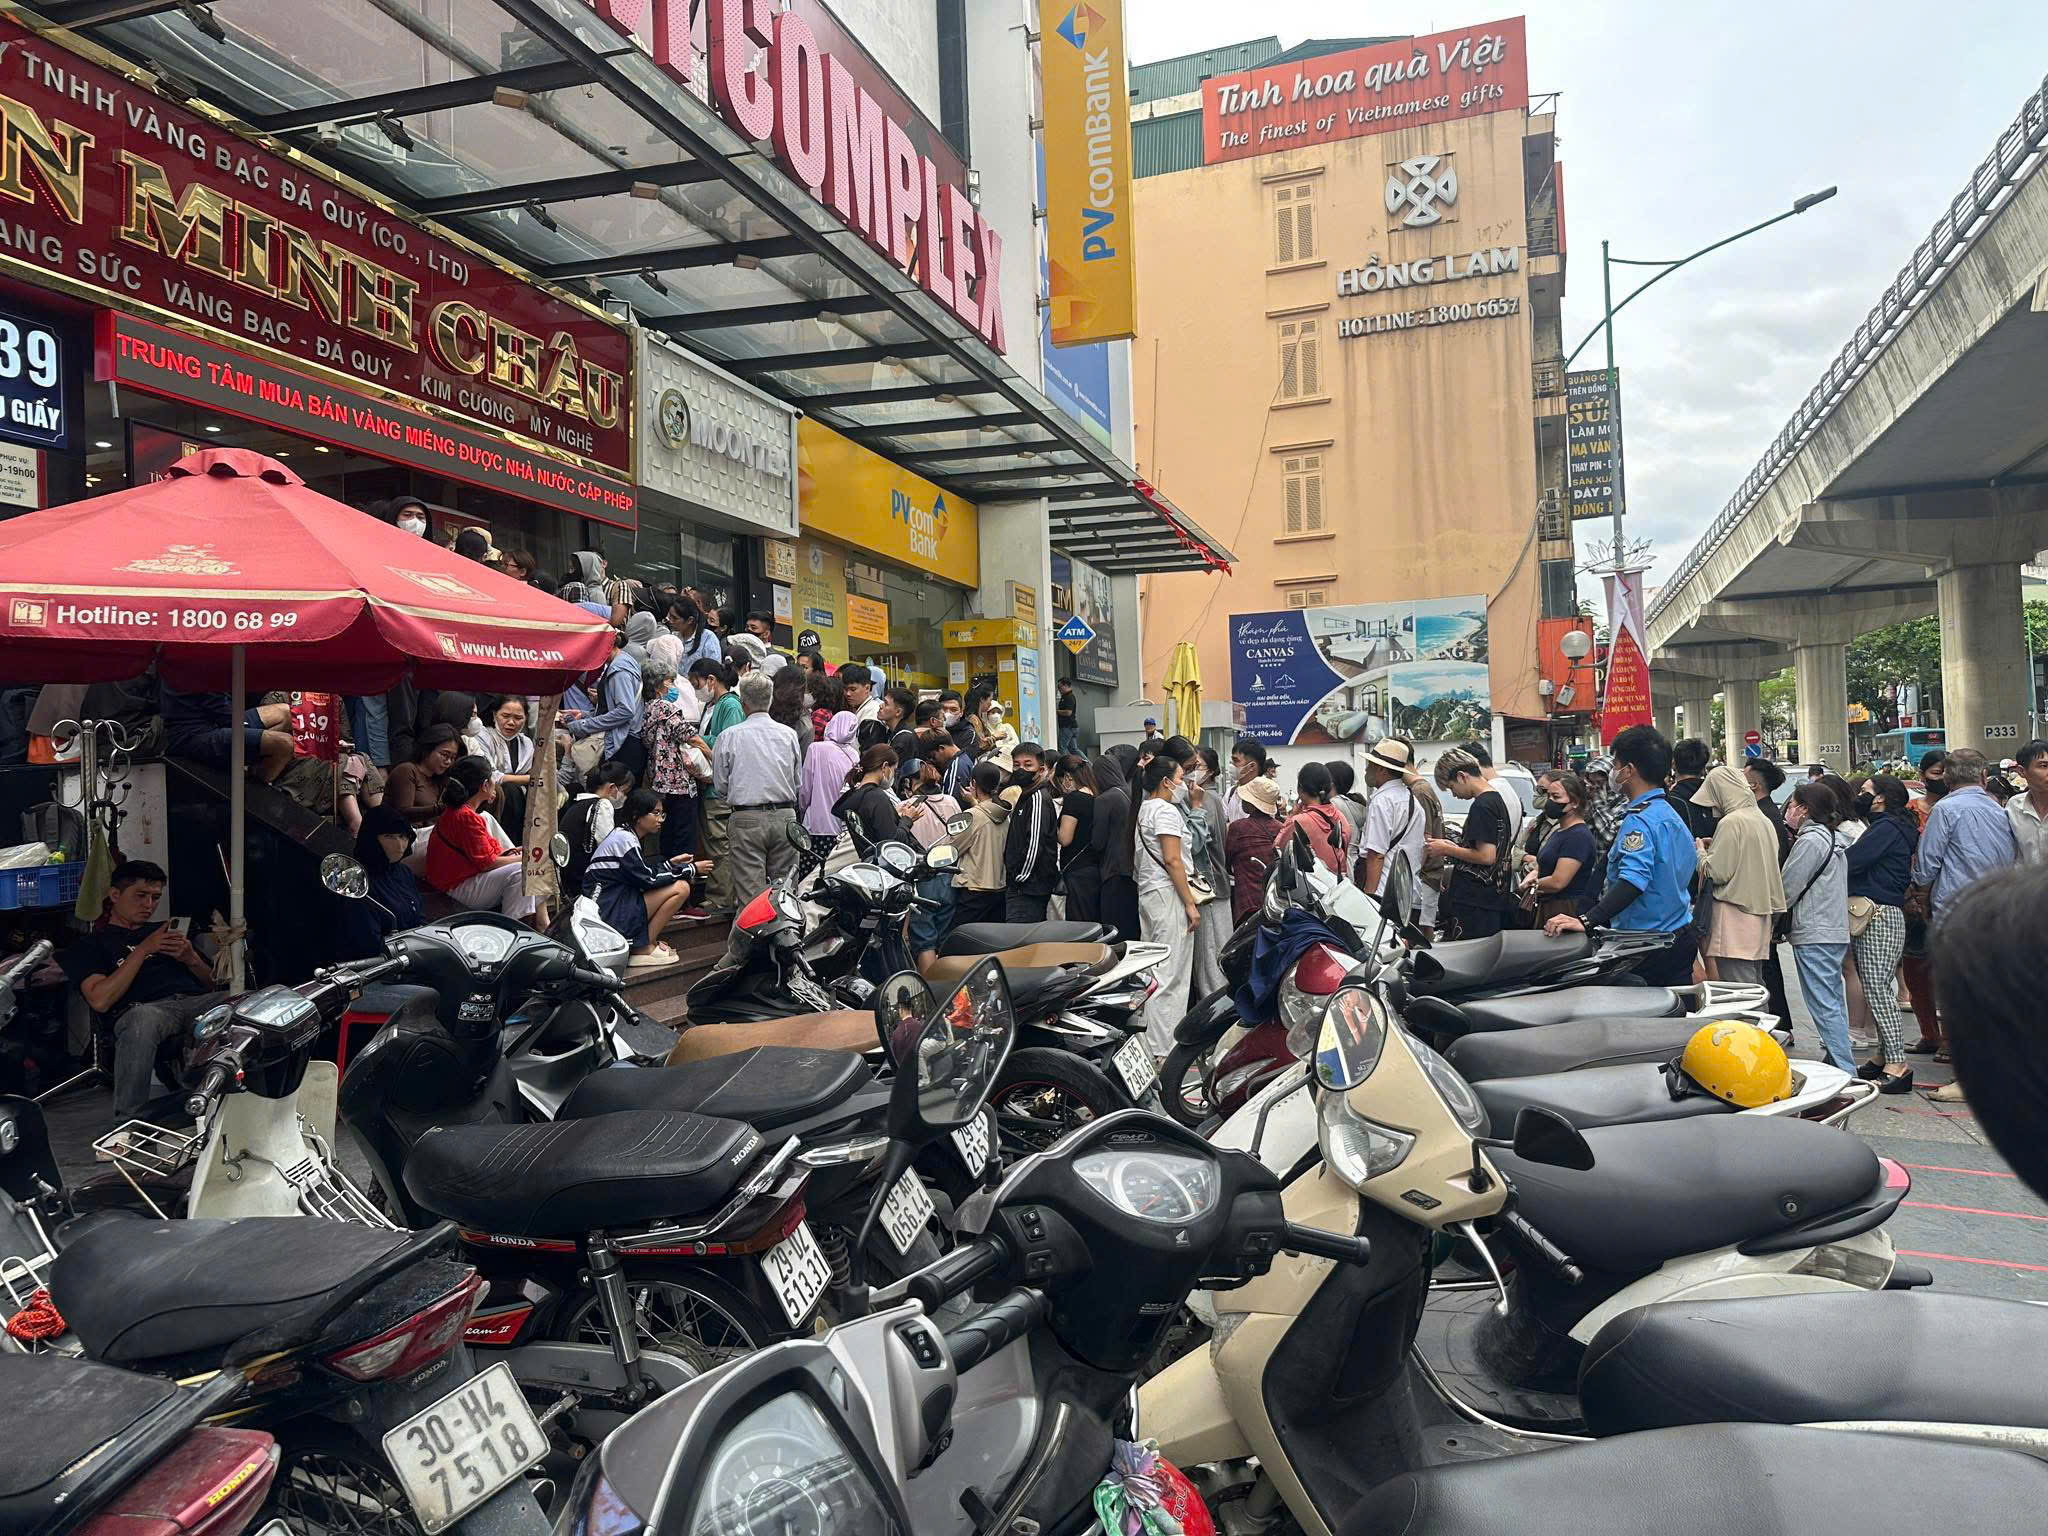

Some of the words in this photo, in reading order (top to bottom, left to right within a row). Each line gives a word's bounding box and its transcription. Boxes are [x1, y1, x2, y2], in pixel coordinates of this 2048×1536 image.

[1217, 79, 1283, 116] Tinh
[1292, 71, 1355, 102] hoa
[1364, 48, 1430, 92] quà
[1437, 34, 1507, 75] Việt
[1220, 131, 1249, 149] The
[1258, 121, 1308, 144] finest
[1316, 111, 1337, 133] of
[1346, 93, 1450, 124] Vietnamese
[1460, 83, 1504, 108] gifts
[21, 51, 115, 116] TNHH
[126, 101, 206, 160] VÀNG
[216, 147, 269, 190] BẠC
[280, 177, 313, 211] ĐÁ
[322, 200, 368, 236] QUÝ
[372, 222, 420, 265] (CO.,
[427, 250, 469, 286] LTD)
[1082, 47, 1115, 262] PVcomBank
[1337, 252, 1434, 297] HỒNG
[1445, 246, 1520, 281] LAM
[117, 148, 420, 354] MINH
[429, 300, 624, 430] CHÂU
[1476, 298, 1520, 317] 6657
[78, 248, 143, 290] SỨC
[162, 278, 234, 325] VÀNG
[244, 308, 291, 344] BẠC
[316, 336, 345, 365] ĐÁ
[351, 350, 392, 381] QUÝ
[421, 374, 451, 402] KIM
[458, 389, 516, 425] CƯƠNG
[530, 415, 552, 437] MỸ
[557, 426, 594, 455] NGHỆ
[11, 396, 61, 431] GIẤY
[117, 332, 201, 379] TRUNG
[207, 362, 253, 396] TÂM
[259, 379, 304, 412] MUA
[308, 394, 349, 425] BÁN
[352, 407, 401, 440] VÀNG
[458, 443, 502, 472] ĐƯỢC
[505, 457, 534, 483] NHÀ
[537, 468, 576, 495] NƯỚC
[603, 491, 633, 513] PHÉP
[1571, 425, 1594, 438] LÀM
[1571, 443, 1587, 458] MẠ
[1571, 462, 1589, 473] THAY
[1589, 460, 1602, 472] PIN
[911, 527, 938, 561] Bank
[57, 605, 158, 626] Hotline:
[168, 609, 227, 629] 1800
[234, 611, 263, 630] 68
[270, 612, 298, 629] 99
[1064, 628, 1086, 637] ATM
[460, 641, 564, 662] www.btmc.vn
[1246, 646, 1295, 658] CANVAS
[1820, 745, 1840, 753] P332
[1985, 726, 2016, 738] P333
[731, 1134, 759, 1166] HONDA
[892, 1187, 932, 1247] 056.44
[490, 1235, 537, 1247] HONDA
[782, 1249, 830, 1319] 513.31
[410, 1359, 448, 1388] HONDA
[406, 1379, 506, 1467] 30-H4
[207, 1462, 258, 1507] HONDA
[429, 1422, 529, 1516] 7518
